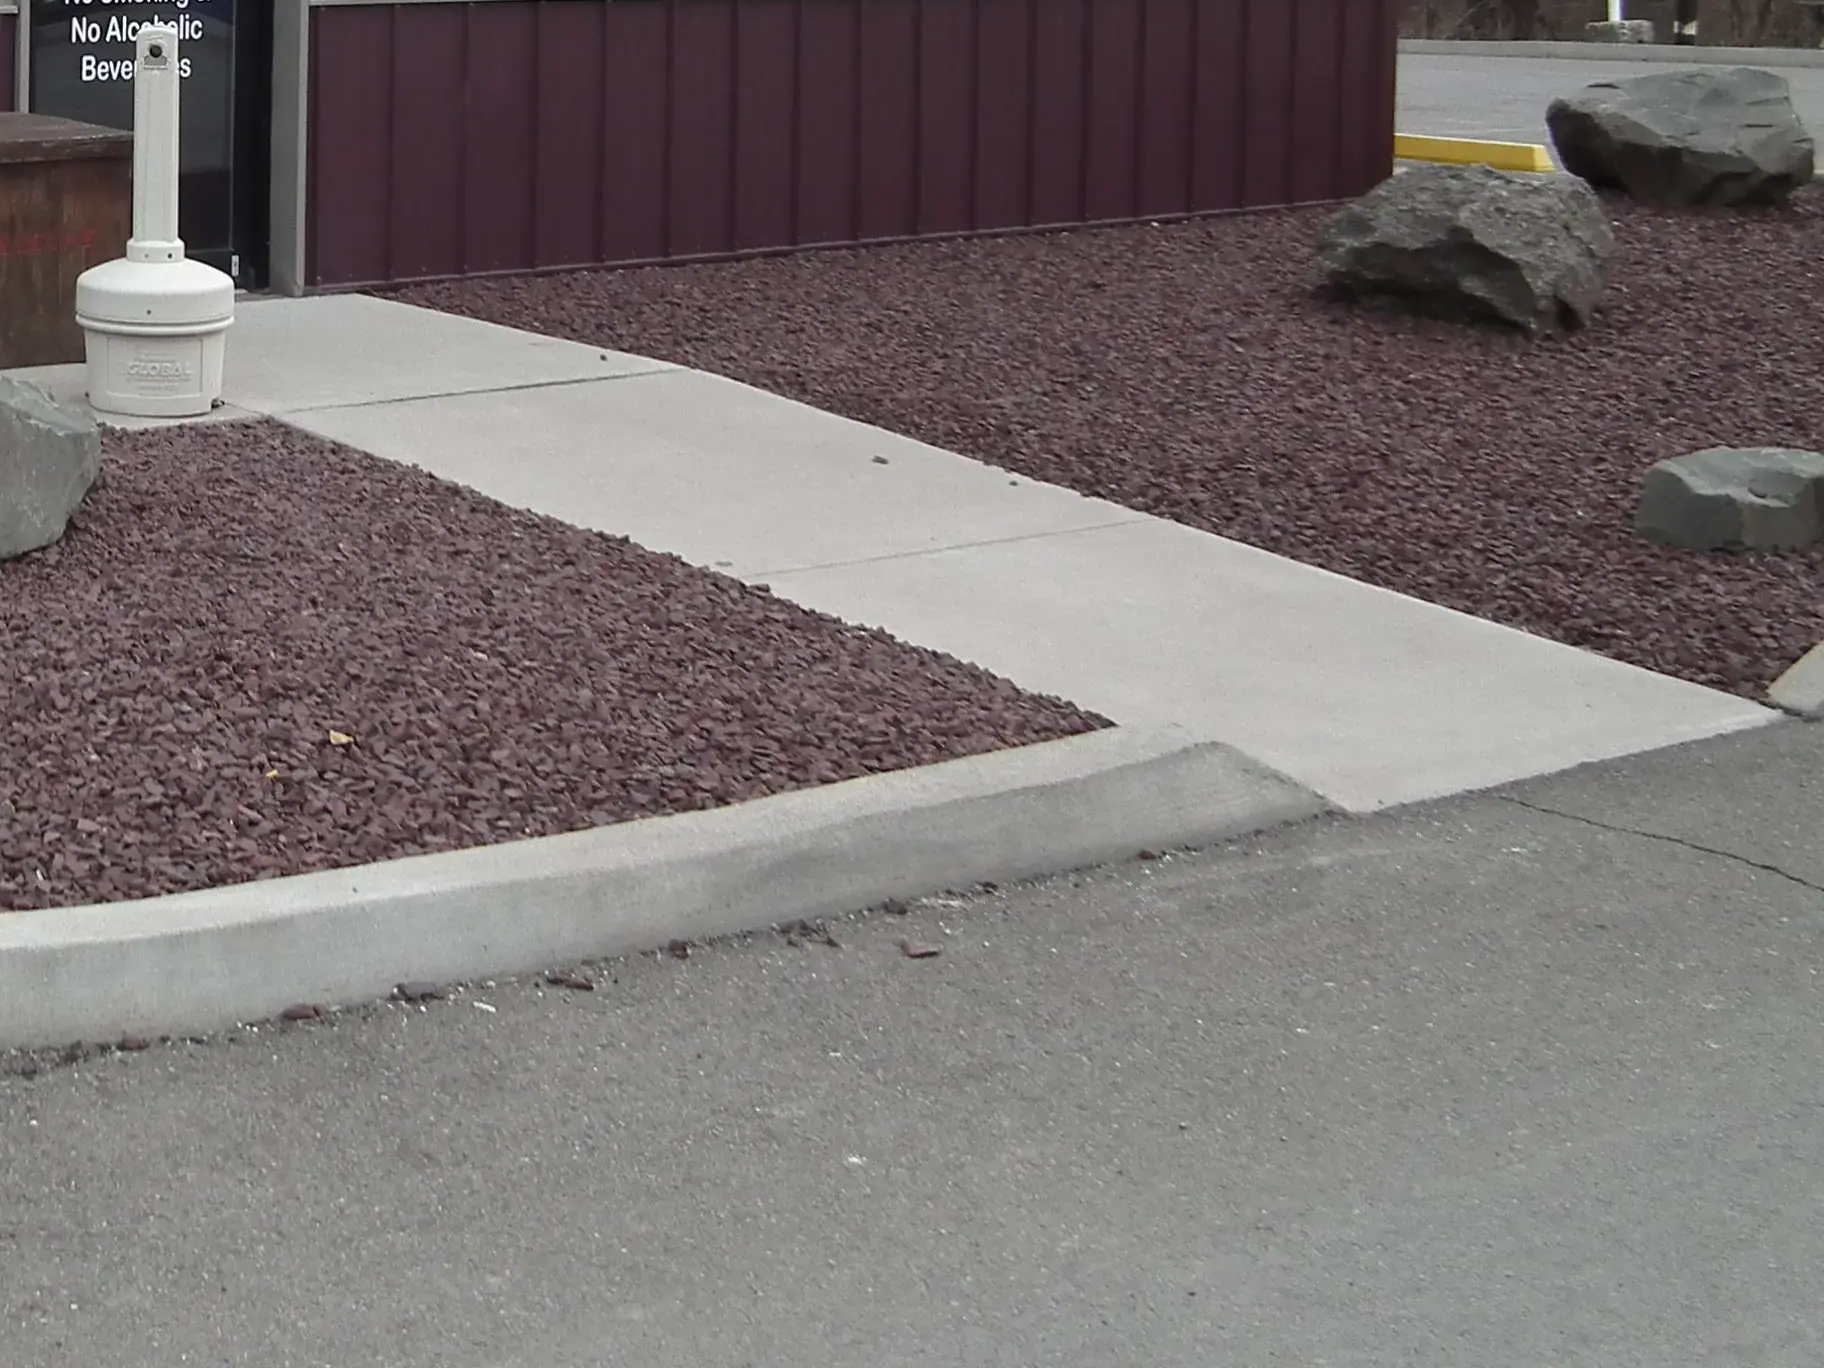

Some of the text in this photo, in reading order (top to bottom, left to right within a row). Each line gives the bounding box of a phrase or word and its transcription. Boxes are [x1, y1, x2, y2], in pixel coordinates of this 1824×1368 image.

[71, 13, 203, 43] No Alclic
[81, 55, 192, 81] Beves
